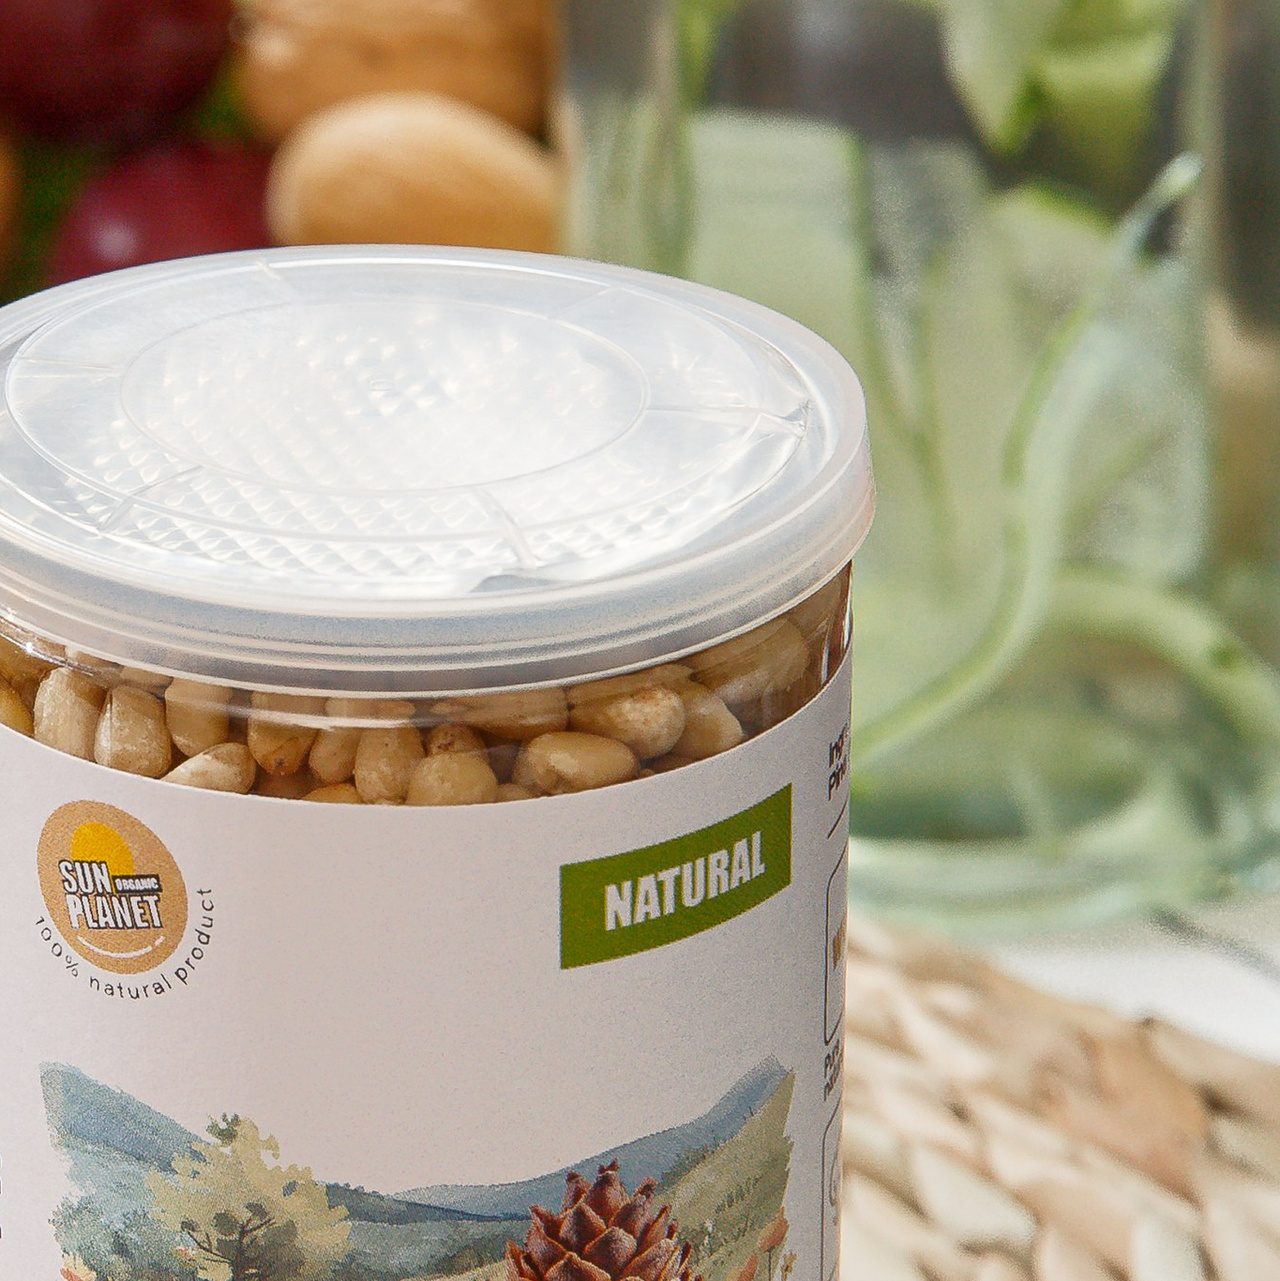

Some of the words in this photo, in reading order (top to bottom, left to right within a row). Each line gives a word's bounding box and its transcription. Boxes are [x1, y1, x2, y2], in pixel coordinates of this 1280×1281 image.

[58, 859, 114, 895] SUN
[114, 877, 161, 893] ORGANIC
[65, 892, 164, 930] PLANET
[605, 830, 766, 931] NATURAL
[34, 915, 80, 978] 100%
[89, 972, 172, 1000] natural
[174, 887, 216, 985] product
